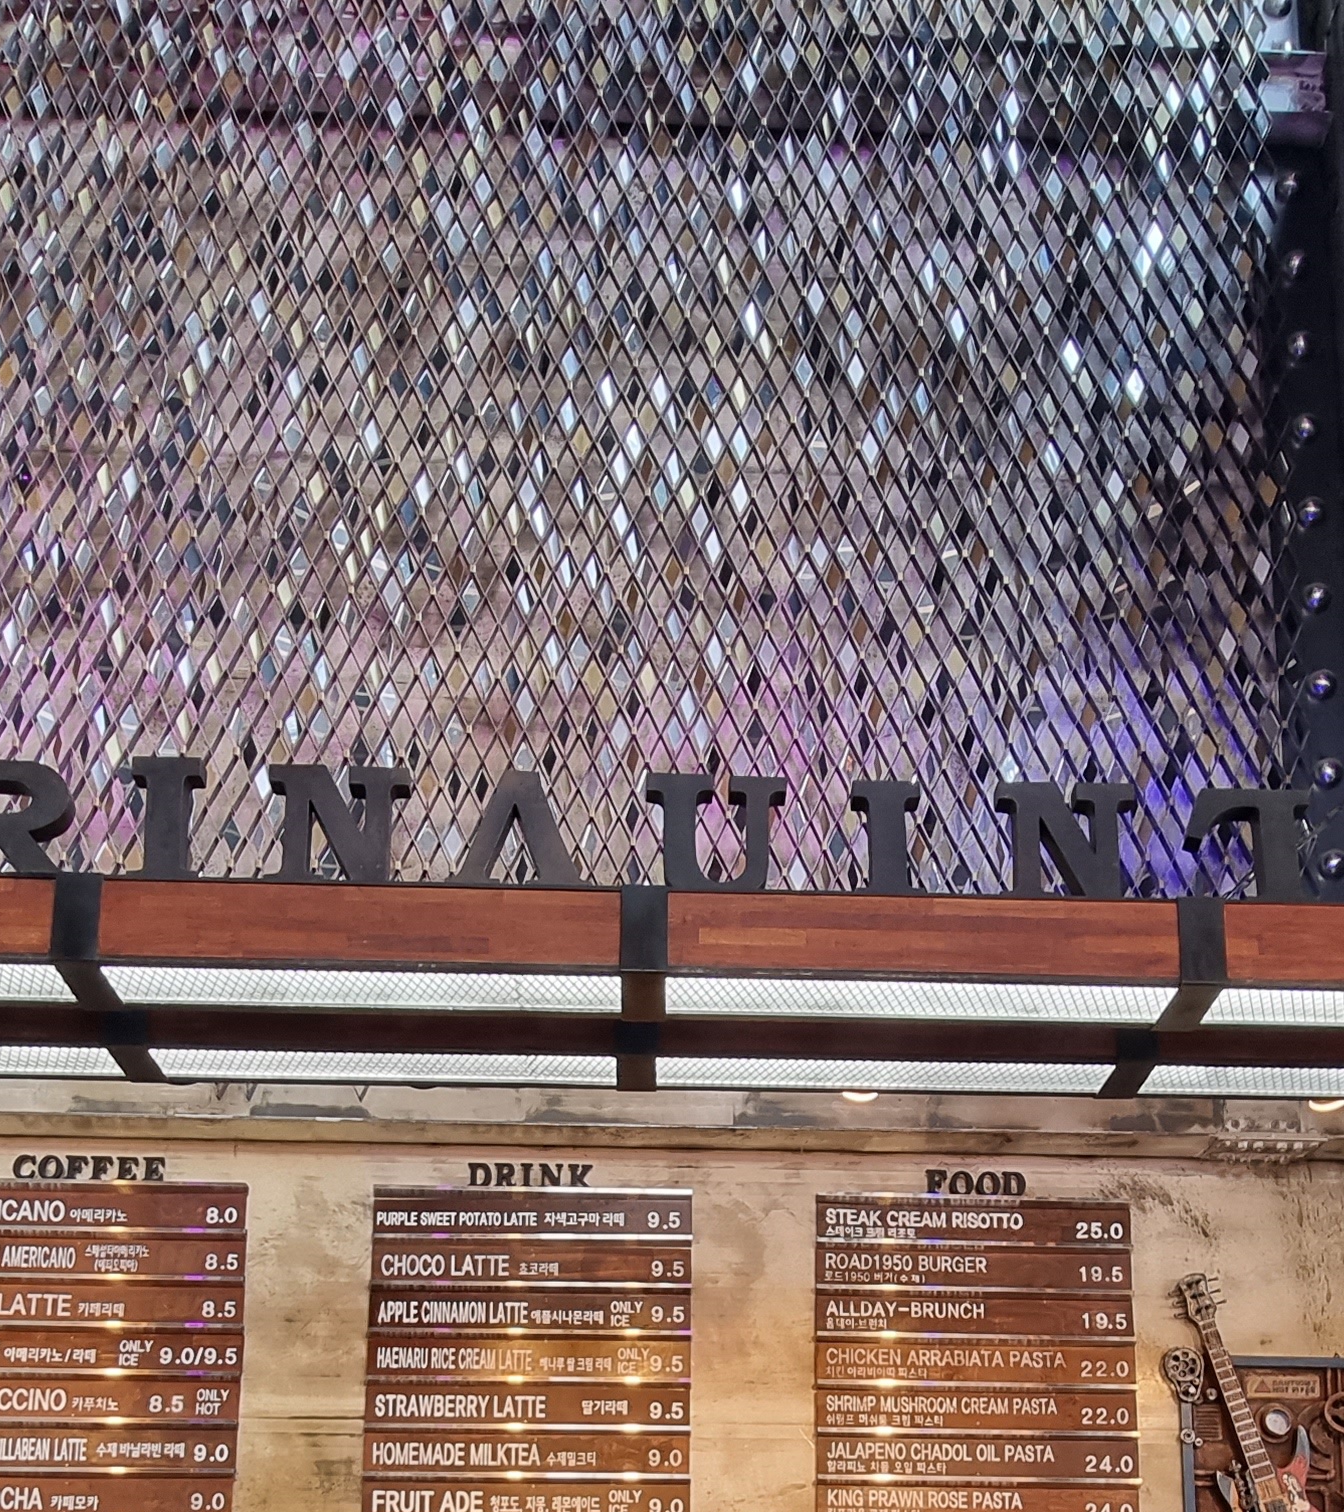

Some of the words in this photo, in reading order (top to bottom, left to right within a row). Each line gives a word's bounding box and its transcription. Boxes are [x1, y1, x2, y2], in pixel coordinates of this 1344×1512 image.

[13, 1155, 166, 1181] COFFEE
[468, 1162, 594, 1187] DRINK
[925, 1169, 1026, 1196] FOOD
[70, 1208, 128, 1222] 아메리카노
[206, 1207, 237, 1224] 8.0
[826, 1208, 882, 1225] STEAK
[887, 1210, 947, 1228] CREAM
[952, 1212, 1023, 1229] RISOTTO
[1076, 1222, 1123, 1239] 25.0
[1, 1246, 75, 1269] AMERICANO
[205, 1254, 238, 1270] 8.5
[381, 1255, 445, 1276] CHOCO
[451, 1255, 509, 1276] LATTE
[651, 1262, 684, 1277] 9.5
[825, 1254, 912, 1271] ROAD1950
[918, 1257, 987, 1272] BURGER
[1079, 1267, 1123, 1282] 19.5
[202, 1302, 236, 1317] 8.5
[826, 1301, 984, 1319] ALLDAY-BRUNCH
[1082, 1314, 1127, 1329] 19.5
[119, 1353, 139, 1366] ICE
[120, 1340, 152, 1353] ONLY
[160, 1348, 237, 1365] 9.0/9.5
[826, 1349, 901, 1365] CHICKEN
[907, 1350, 1004, 1367] ARRABIATA
[1010, 1352, 1066, 1368] PASTA
[1081, 1361, 1129, 1377] 22.0
[72, 1397, 119, 1412] 카푸치노
[149, 1396, 183, 1413] 8.5
[196, 1389, 229, 1402] ONLY
[196, 1403, 220, 1415] HOT
[375, 1396, 489, 1418] STRAWBERRY
[493, 1396, 546, 1418] LATTE
[582, 1401, 628, 1415] 딸기라떼
[649, 1403, 683, 1419] 9.5
[373, 1443, 465, 1465] HOMEMADE
[470, 1443, 540, 1465] MILKTEA
[547, 1452, 596, 1466] 수제밀크티
[649, 1450, 682, 1466] 9.0
[51, 1495, 98, 1510] 카페모카
[191, 1493, 225, 1510] 9.0
[372, 1491, 434, 1512] FRUIT
[440, 1491, 483, 1512] ADE
[608, 1490, 641, 1503] ONLY
